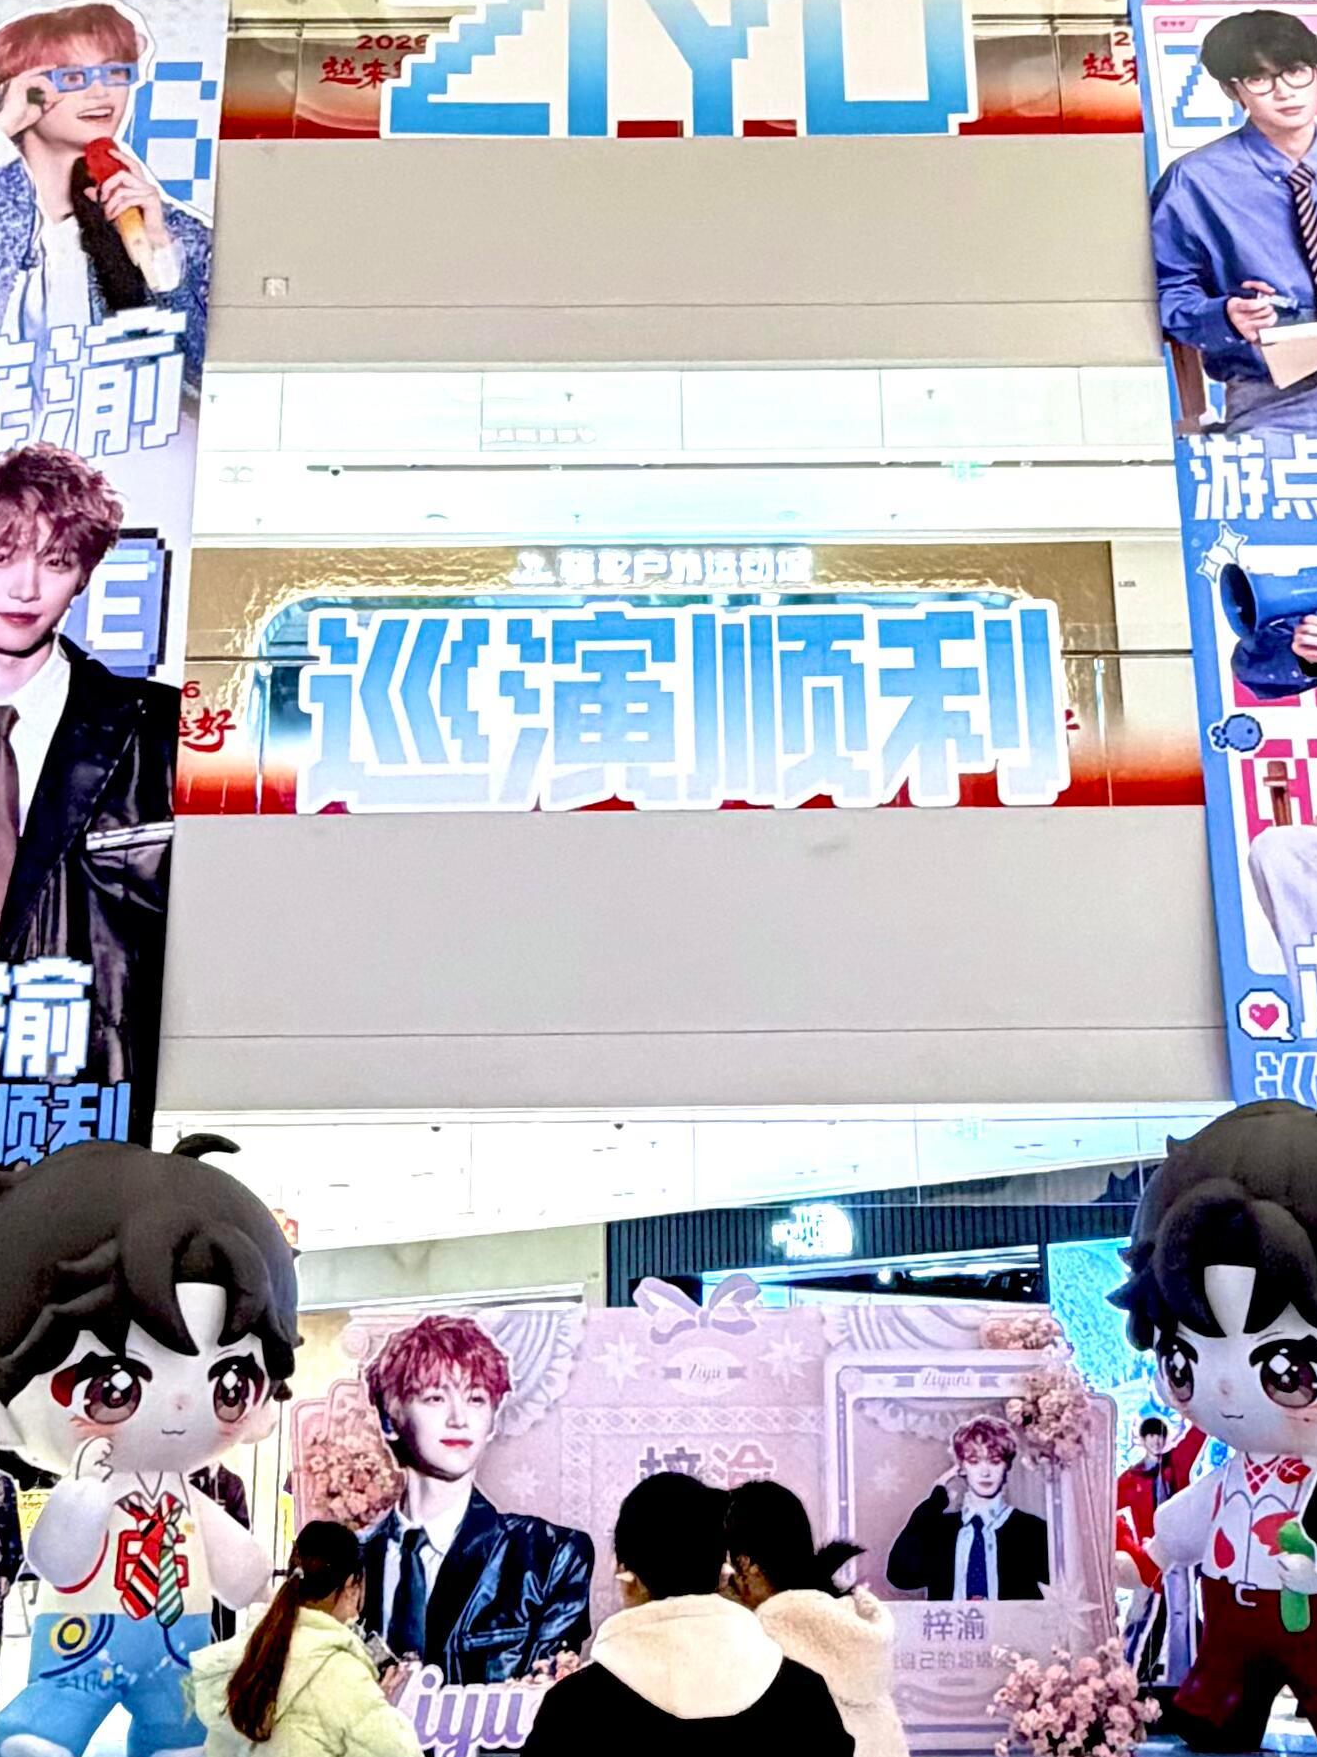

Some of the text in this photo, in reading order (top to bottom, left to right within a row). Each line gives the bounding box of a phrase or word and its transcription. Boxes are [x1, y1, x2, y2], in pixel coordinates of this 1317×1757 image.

[303, 605, 1066, 810] 巡演顺利
[923, 1607, 985, 1641] 梓渝
